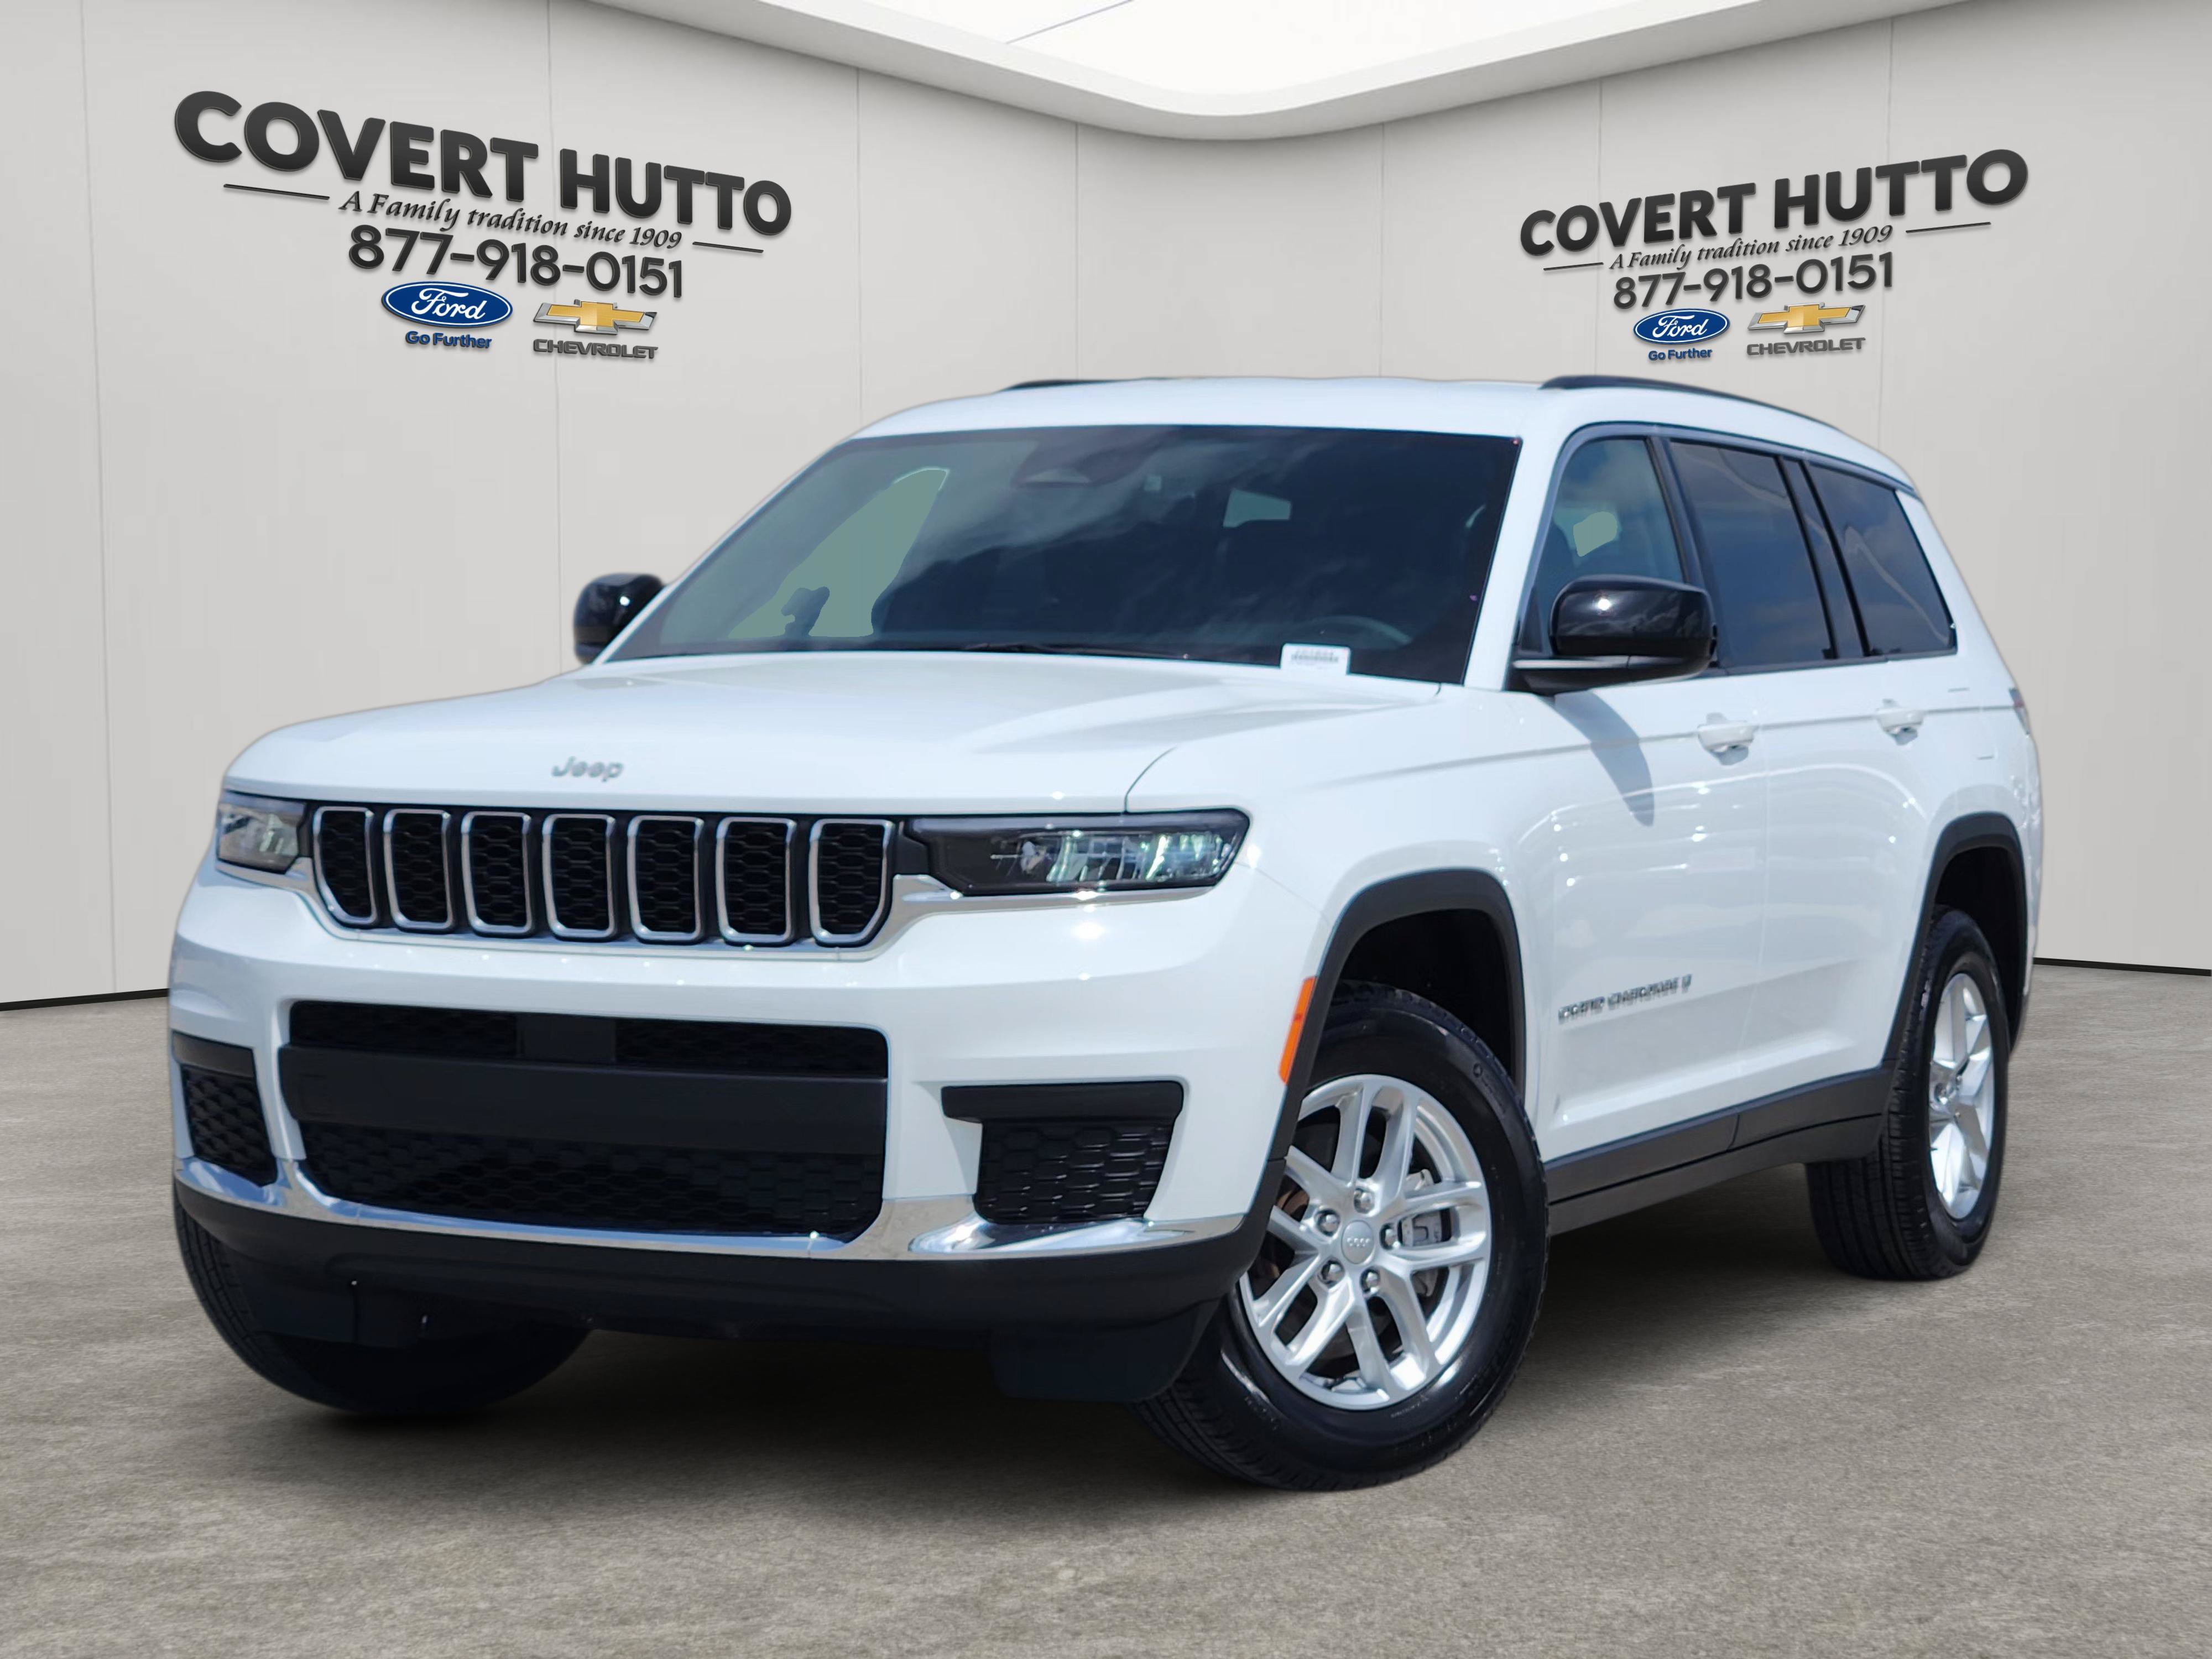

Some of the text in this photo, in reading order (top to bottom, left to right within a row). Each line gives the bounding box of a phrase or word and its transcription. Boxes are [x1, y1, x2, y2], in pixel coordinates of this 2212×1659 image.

[175, 91, 791, 236] COVERT HUTTO
[339, 190, 682, 249] A Family tradition since 1909
[1520, 149, 2028, 257] COVERT HUTTO
[348, 225, 682, 299] 877-918-0151
[1609, 224, 1893, 270] A Family tradition since 1909
[1614, 251, 1892, 310] 877-918-0151
[411, 286, 487, 321] Ford
[405, 330, 492, 350] Go Further
[1652, 315, 1708, 338] Ford
[533, 339, 658, 359] CHEVROLET
[1648, 347, 1713, 361] Go Further
[1746, 337, 1866, 356] CHEVROLET
[552, 755, 624, 782] Jeep
